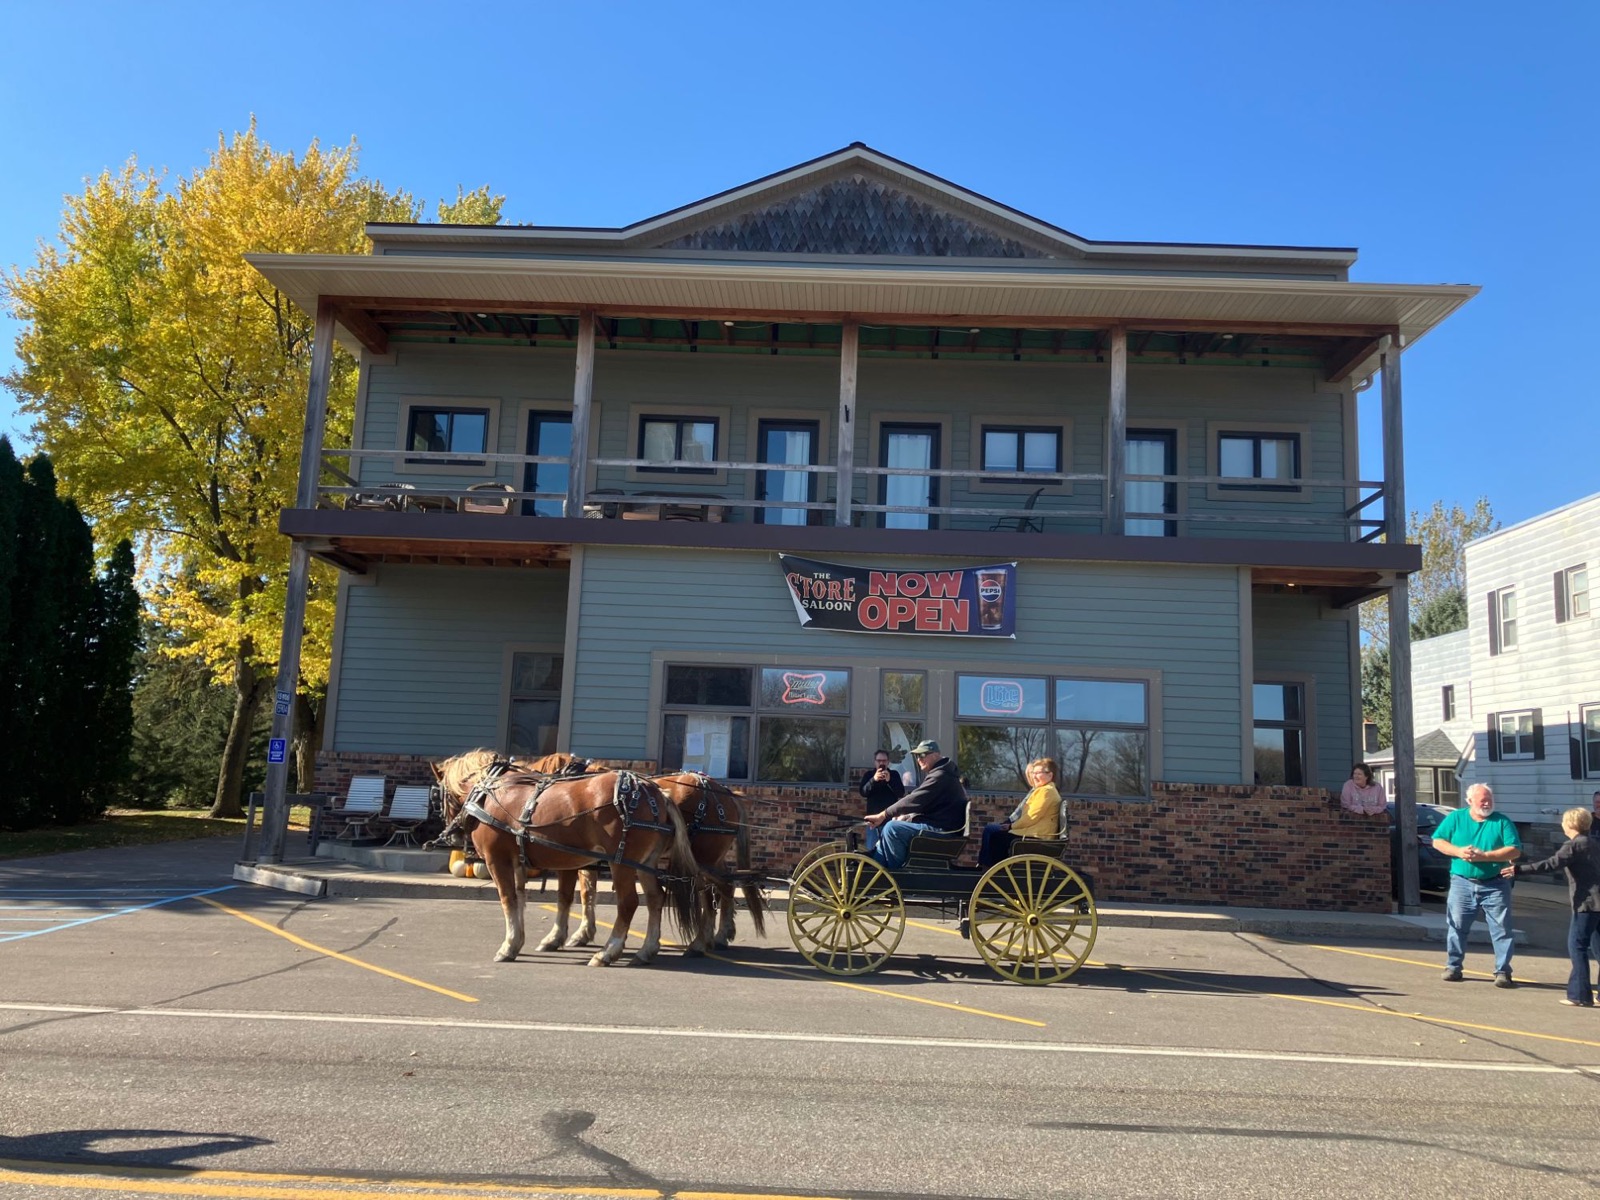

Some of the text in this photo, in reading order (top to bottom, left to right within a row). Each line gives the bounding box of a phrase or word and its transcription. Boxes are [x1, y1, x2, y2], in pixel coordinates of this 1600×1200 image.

[813, 572, 831, 580] THE
[869, 571, 963, 598] NOW
[802, 601, 852, 611] SALOON
[857, 596, 969, 632] OPEN
